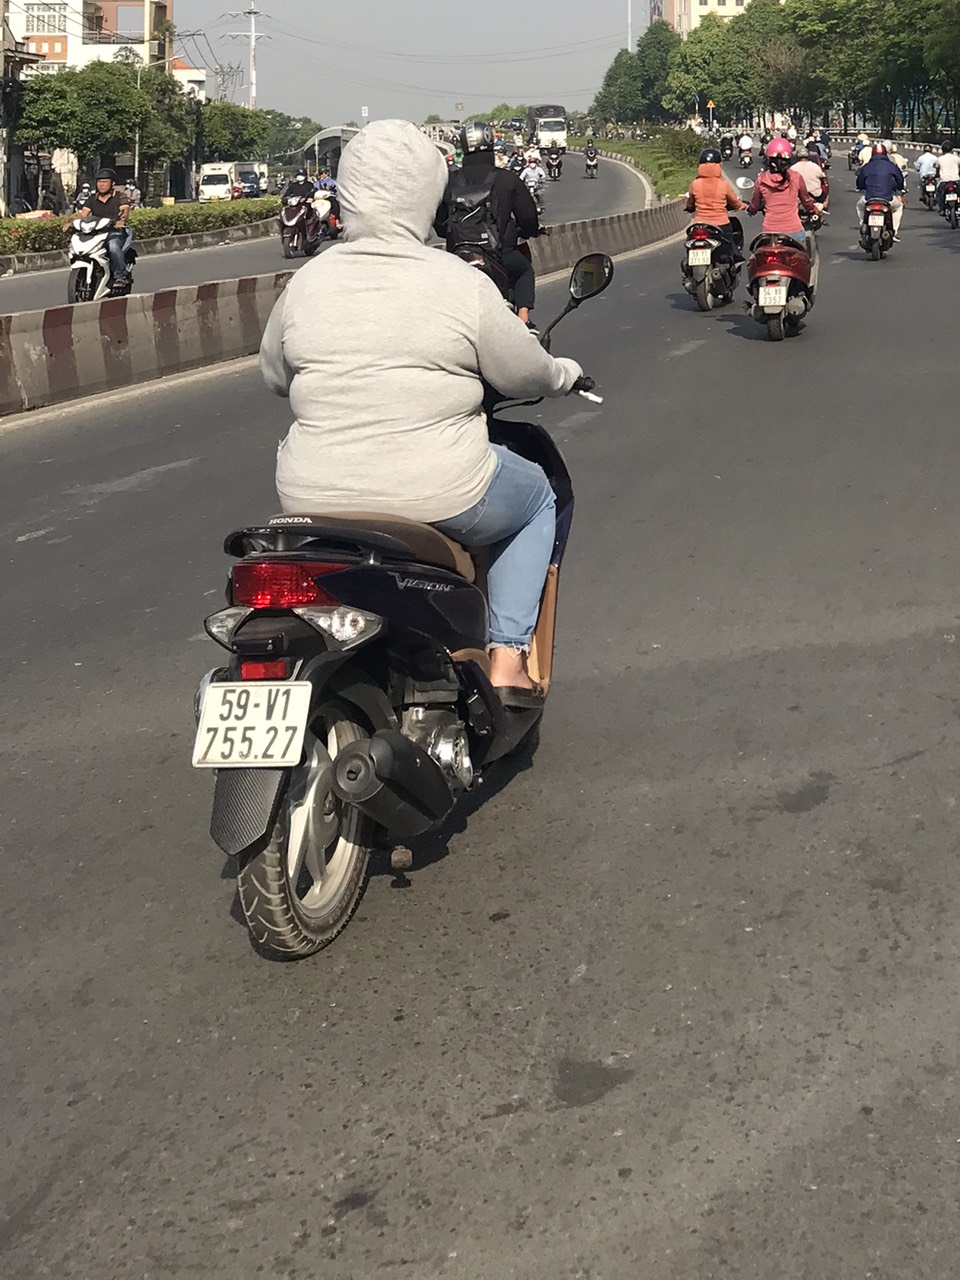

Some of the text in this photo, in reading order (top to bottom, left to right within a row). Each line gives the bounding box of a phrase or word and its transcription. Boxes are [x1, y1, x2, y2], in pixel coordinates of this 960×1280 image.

[269, 516, 312, 525] HONDA
[219, 688, 291, 721] 59-V1
[200, 726, 298, 760] 755.27
